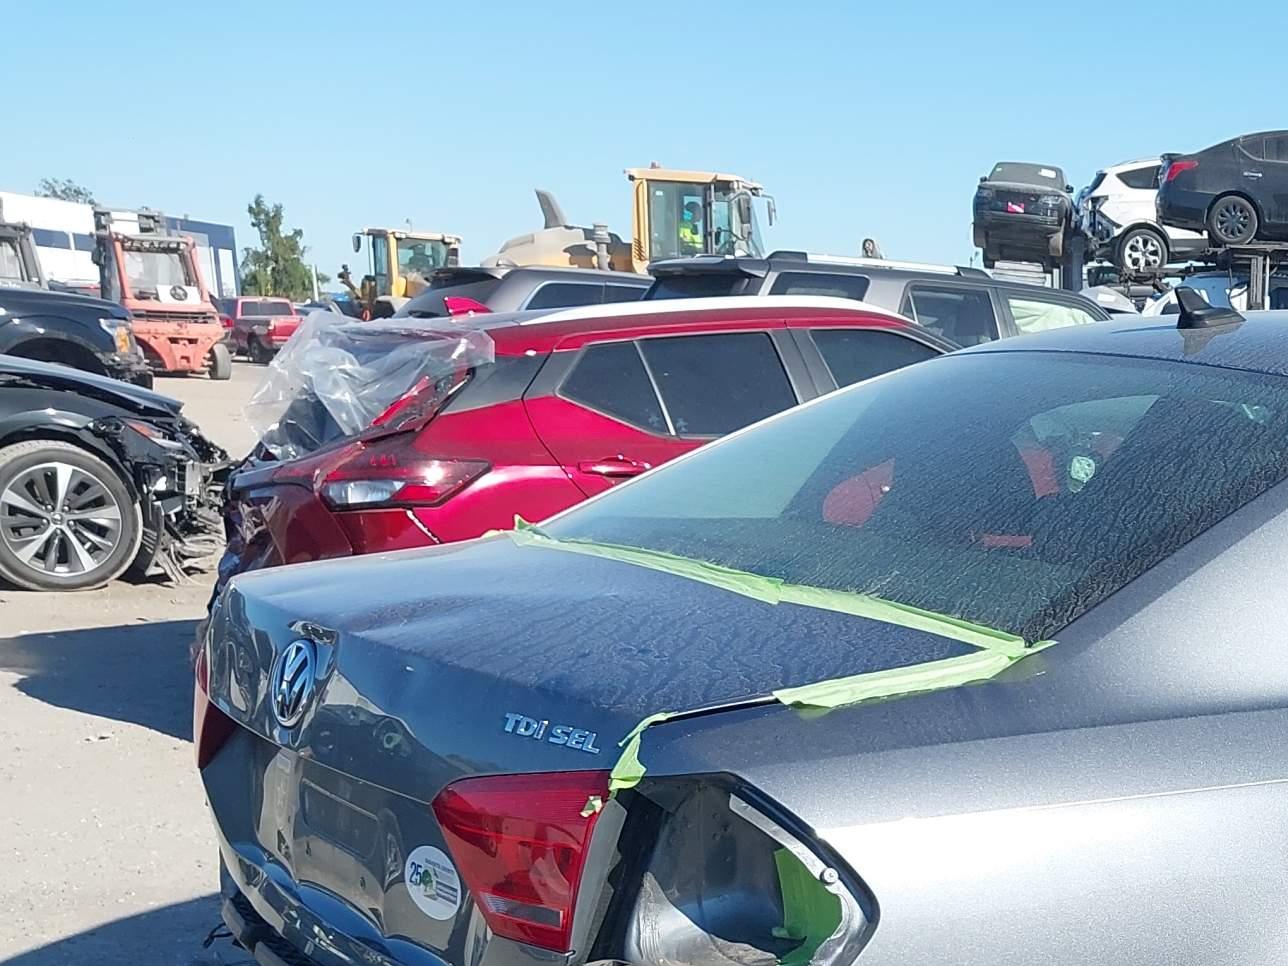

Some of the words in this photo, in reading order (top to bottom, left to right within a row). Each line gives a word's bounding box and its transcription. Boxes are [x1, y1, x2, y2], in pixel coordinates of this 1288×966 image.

[504, 712, 549, 740] TDI
[548, 725, 600, 754] SEL
[409, 861, 423, 887] 25
